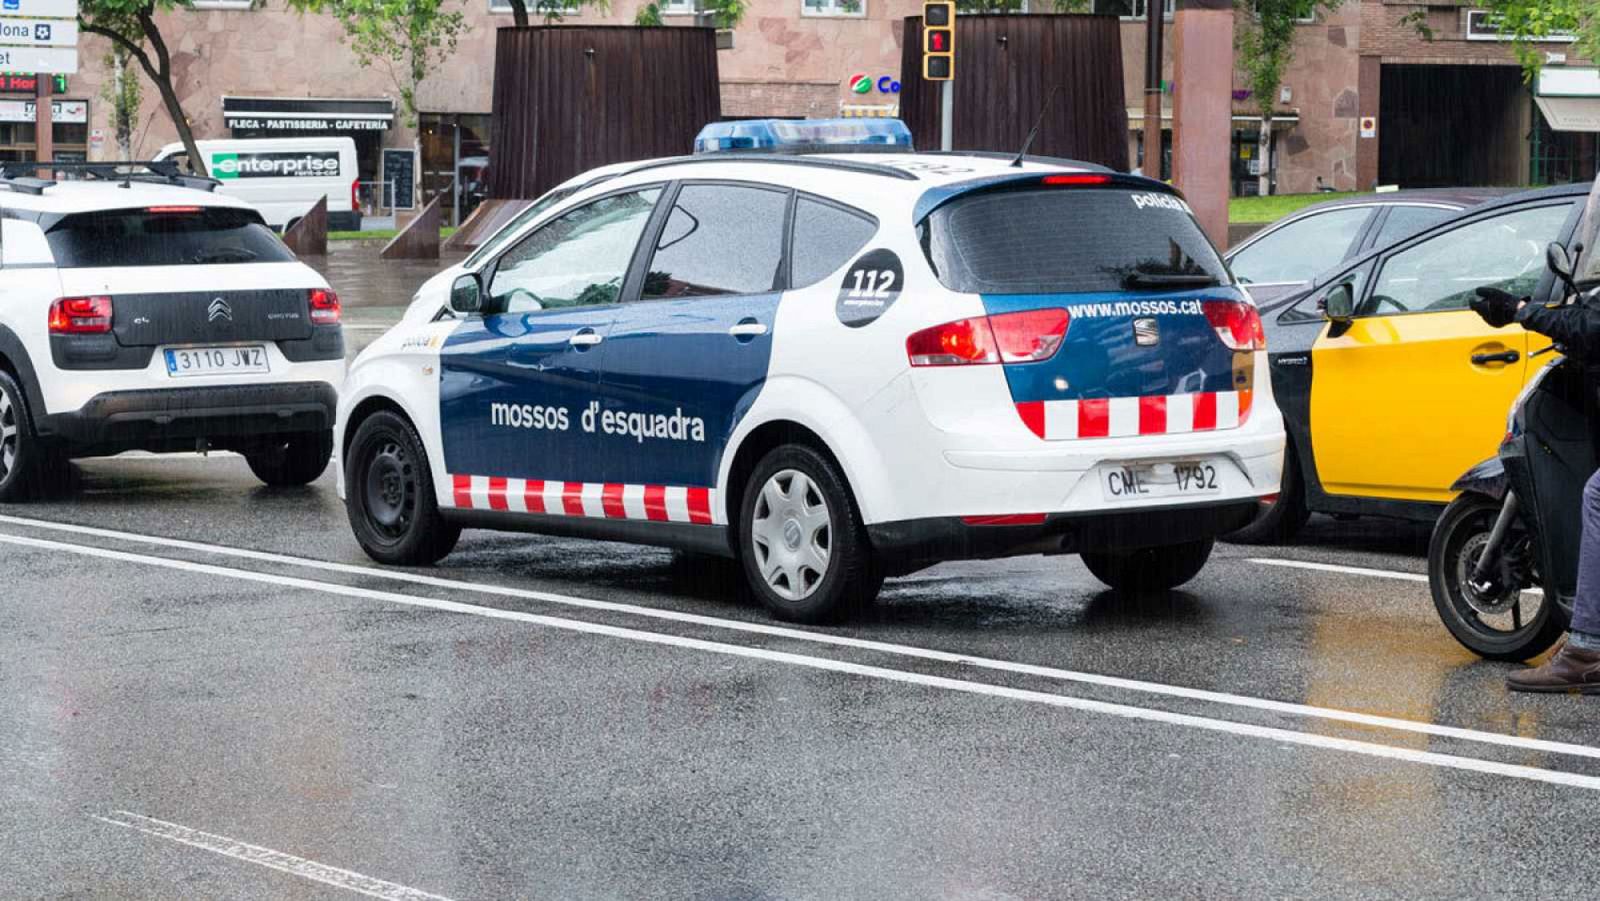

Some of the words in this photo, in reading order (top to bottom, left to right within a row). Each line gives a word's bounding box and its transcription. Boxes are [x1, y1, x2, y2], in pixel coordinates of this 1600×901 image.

[229, 119, 260, 129] FLECA
[267, 119, 328, 129] PASTISSERIA
[219, 154, 338, 175] enterprise
[848, 269, 896, 298] 112
[1067, 299, 1204, 319] www.mossos.cat
[180, 350, 225, 369] 3110
[232, 349, 262, 367] JWZ
[491, 402, 569, 430] mossos
[581, 401, 705, 443] d'esquadra
[1108, 470, 1149, 495] CME
[1174, 465, 1218, 491] 1792
